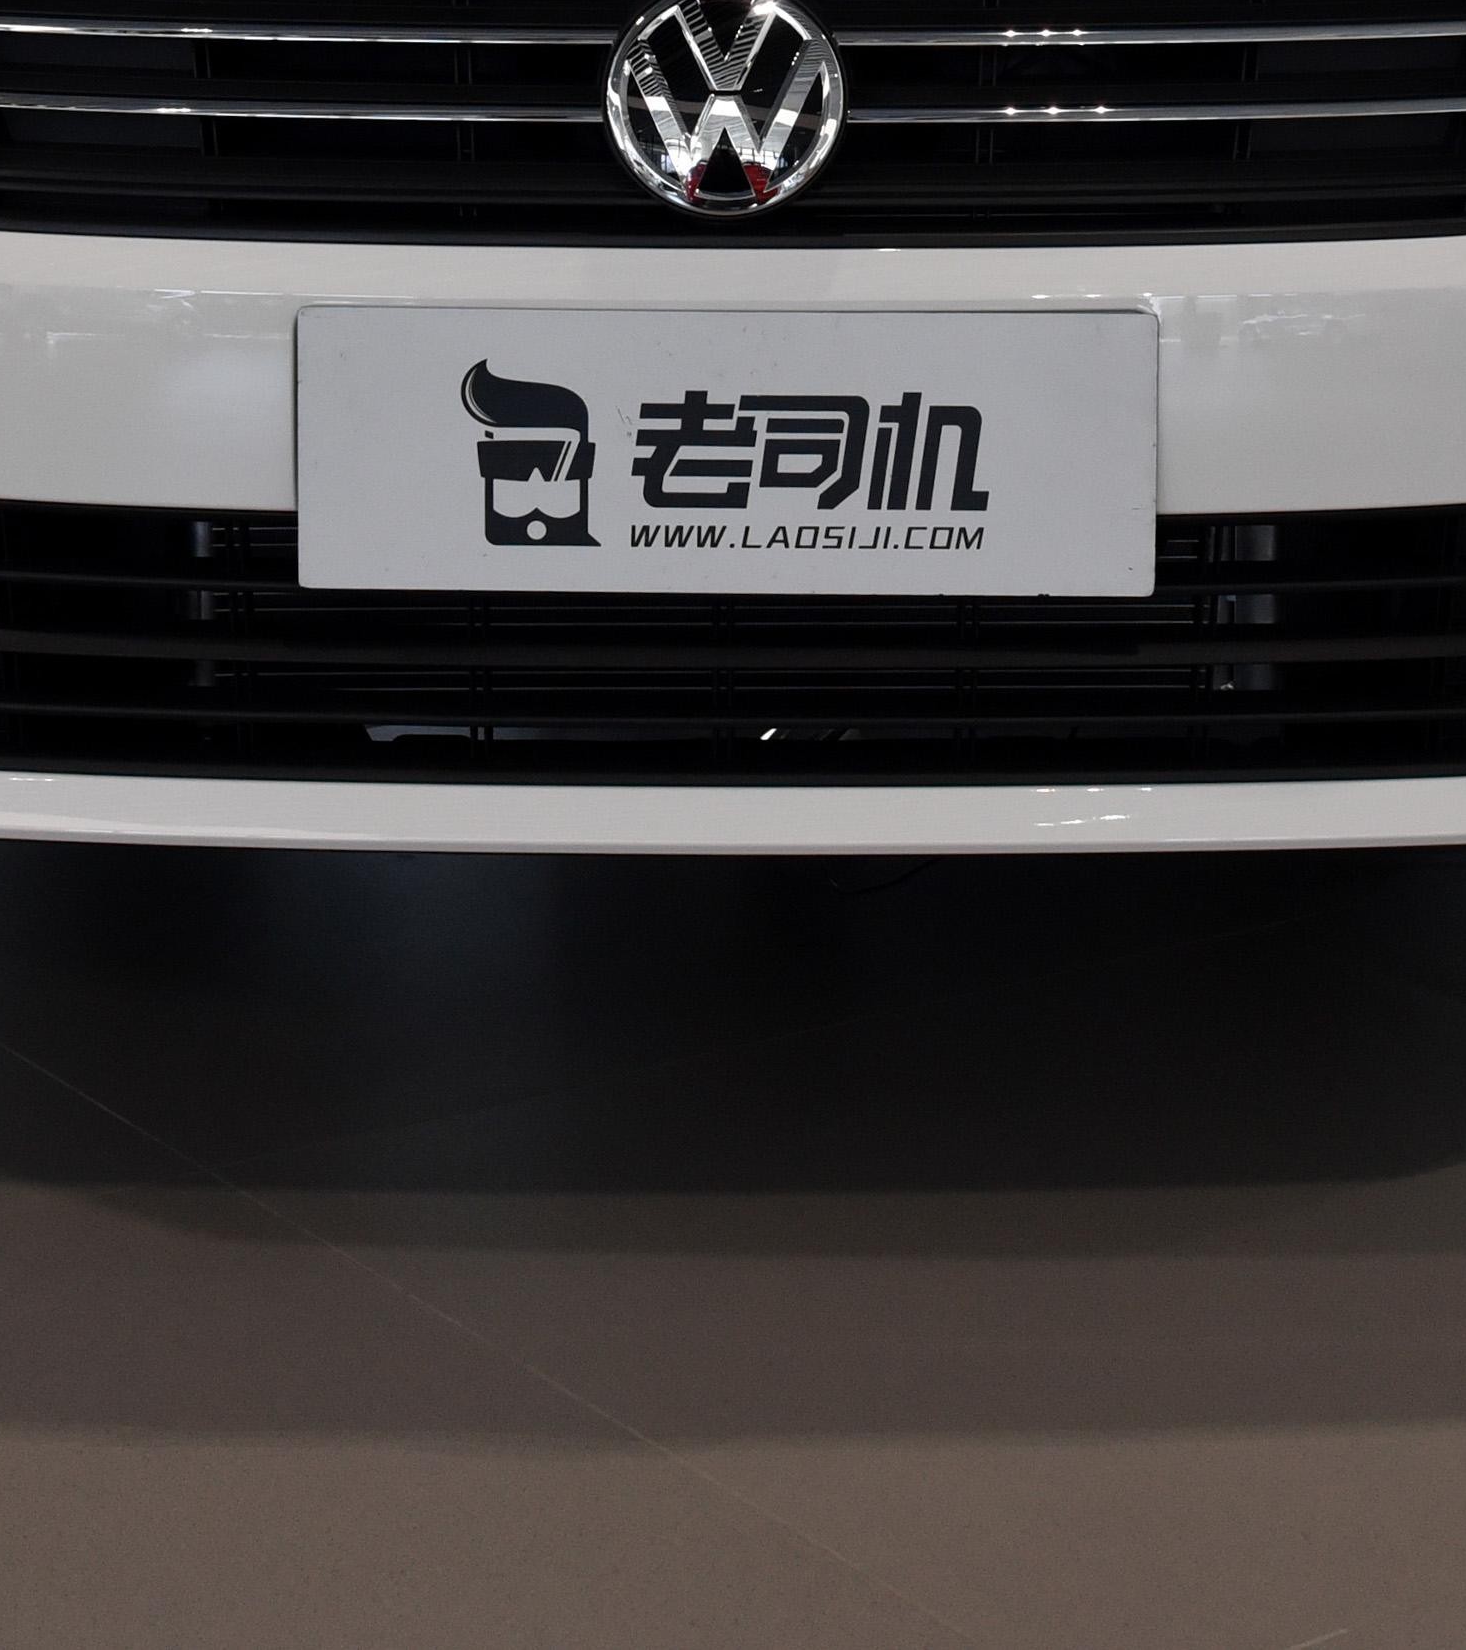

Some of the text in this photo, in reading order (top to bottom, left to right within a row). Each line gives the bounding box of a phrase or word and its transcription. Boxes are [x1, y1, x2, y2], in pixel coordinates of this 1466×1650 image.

[631, 390, 990, 511] 老司机
[630, 524, 985, 550] WWW.LAOSIJI.COM
